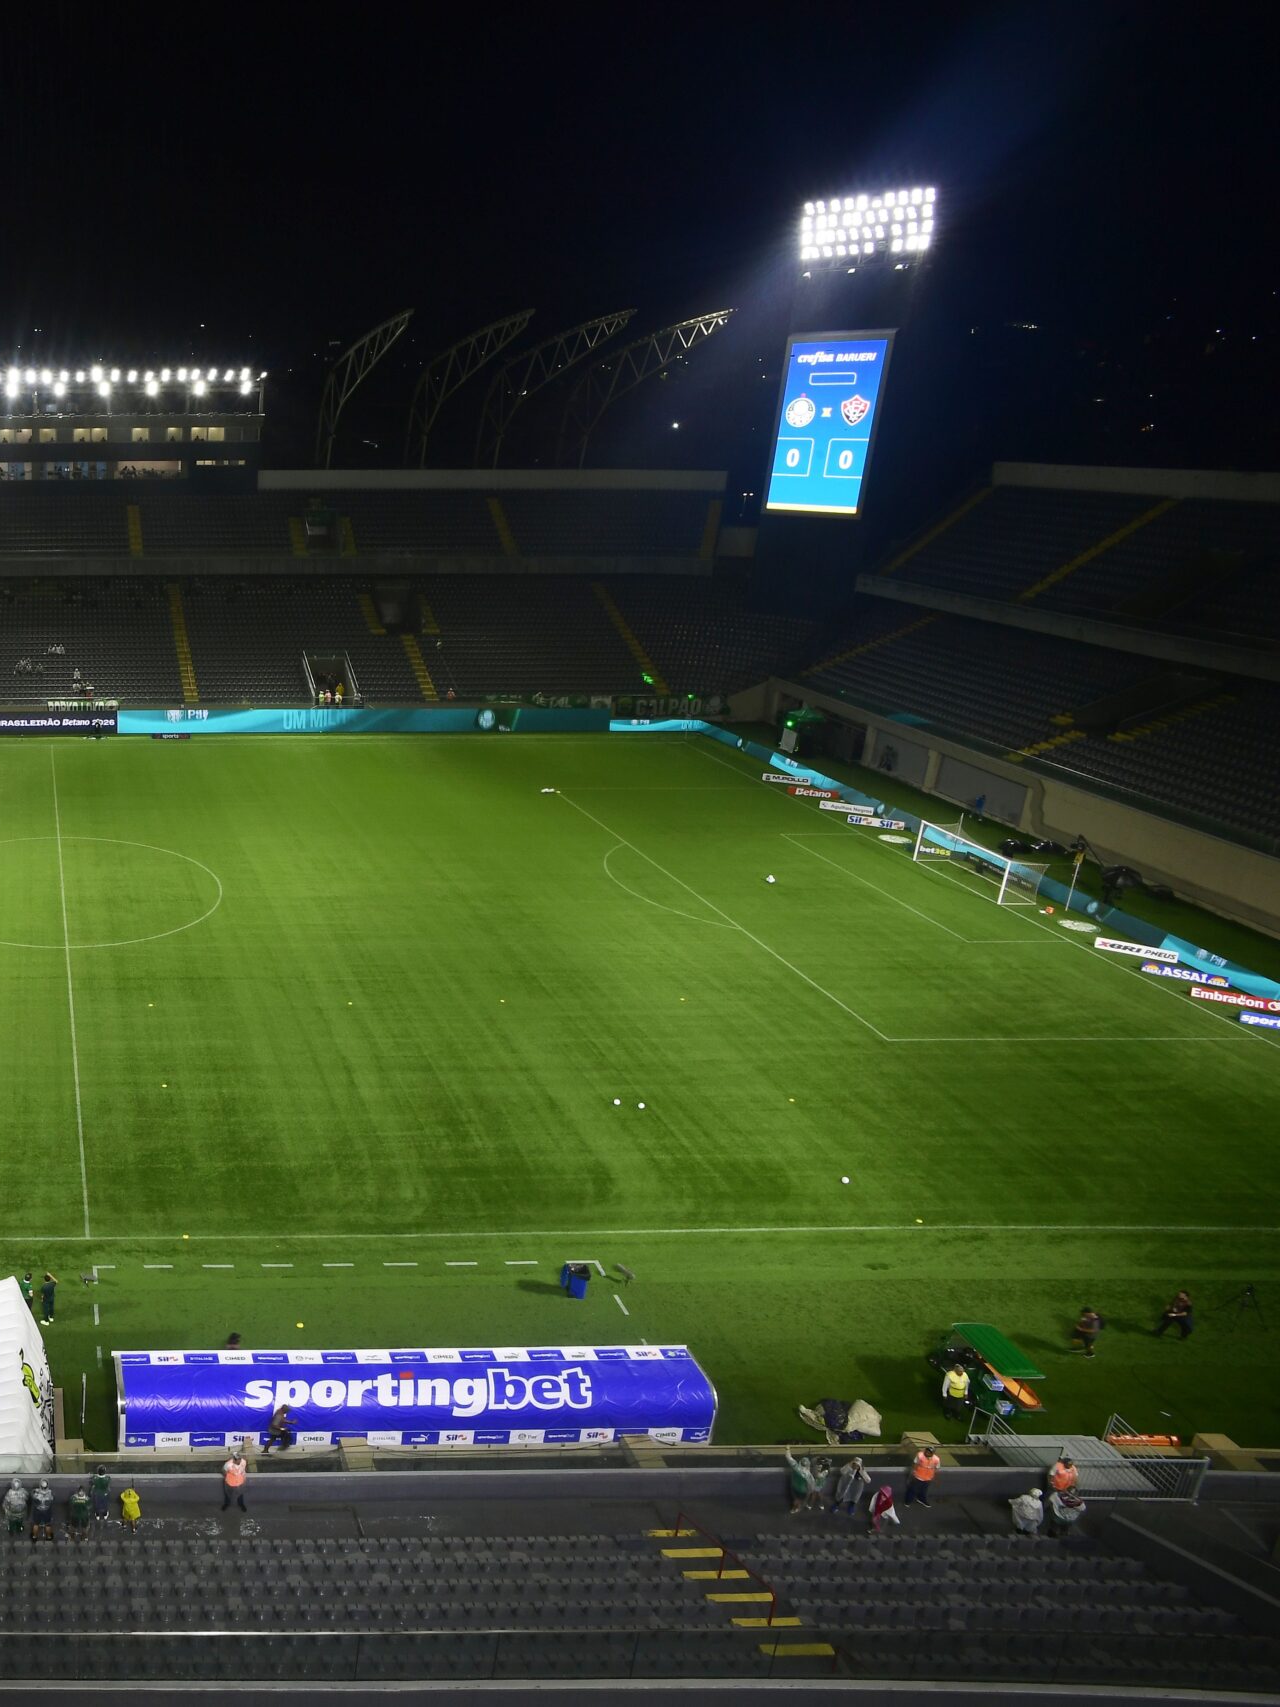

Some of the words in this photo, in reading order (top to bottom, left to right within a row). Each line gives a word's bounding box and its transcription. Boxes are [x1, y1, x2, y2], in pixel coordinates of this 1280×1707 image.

[797, 351, 833, 365] crefisa
[835, 352, 877, 362] BARUERI
[786, 448, 800, 468] 0
[838, 449, 853, 470] 0
[62, 718, 90, 727] Betano
[283, 710, 306, 730] UM
[795, 787, 832, 799] Betano
[848, 815, 862, 823] Sil
[880, 820, 893, 828] Sil
[919, 845, 951, 856] bet365
[1144, 948, 1176, 961] PNEUS
[1191, 987, 1264, 1009] Embracon
[244, 1367, 593, 1417] sportingbet
[137, 1436, 148, 1444] Pay
[446, 1434, 458, 1442] Sil
[586, 1431, 599, 1439] Sil
